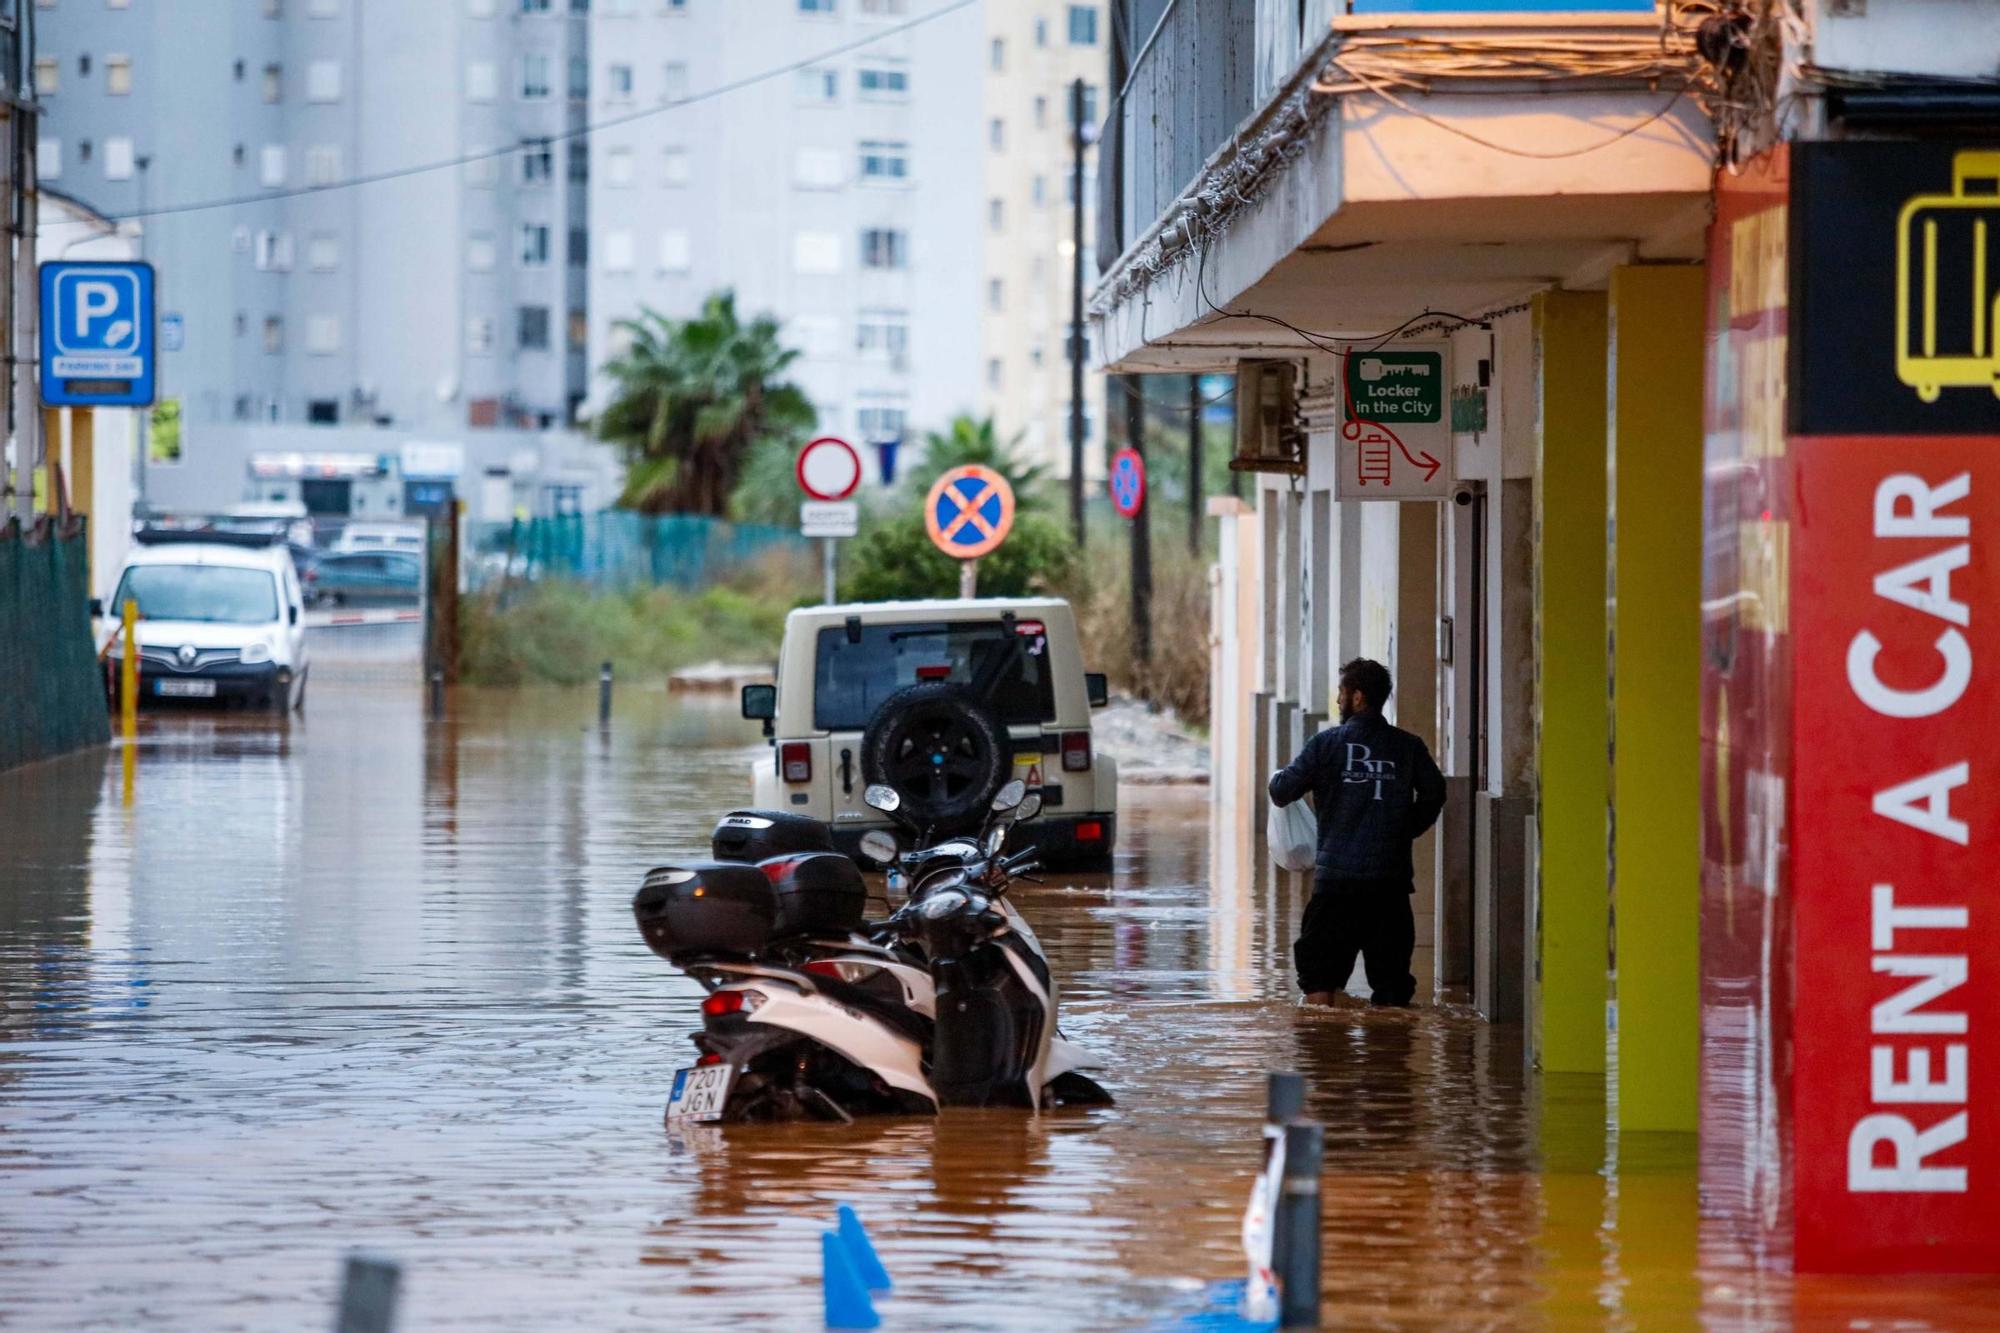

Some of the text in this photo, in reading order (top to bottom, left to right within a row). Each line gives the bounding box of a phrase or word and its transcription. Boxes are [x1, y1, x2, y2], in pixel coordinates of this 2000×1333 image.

[76, 281, 119, 337] P
[1368, 384, 1421, 397] Locker
[1356, 401, 1432, 416] in the City
[1846, 471, 1972, 1193] RENT A CAR
[686, 1068, 726, 1091] 7201
[681, 1090, 717, 1113] JGN
